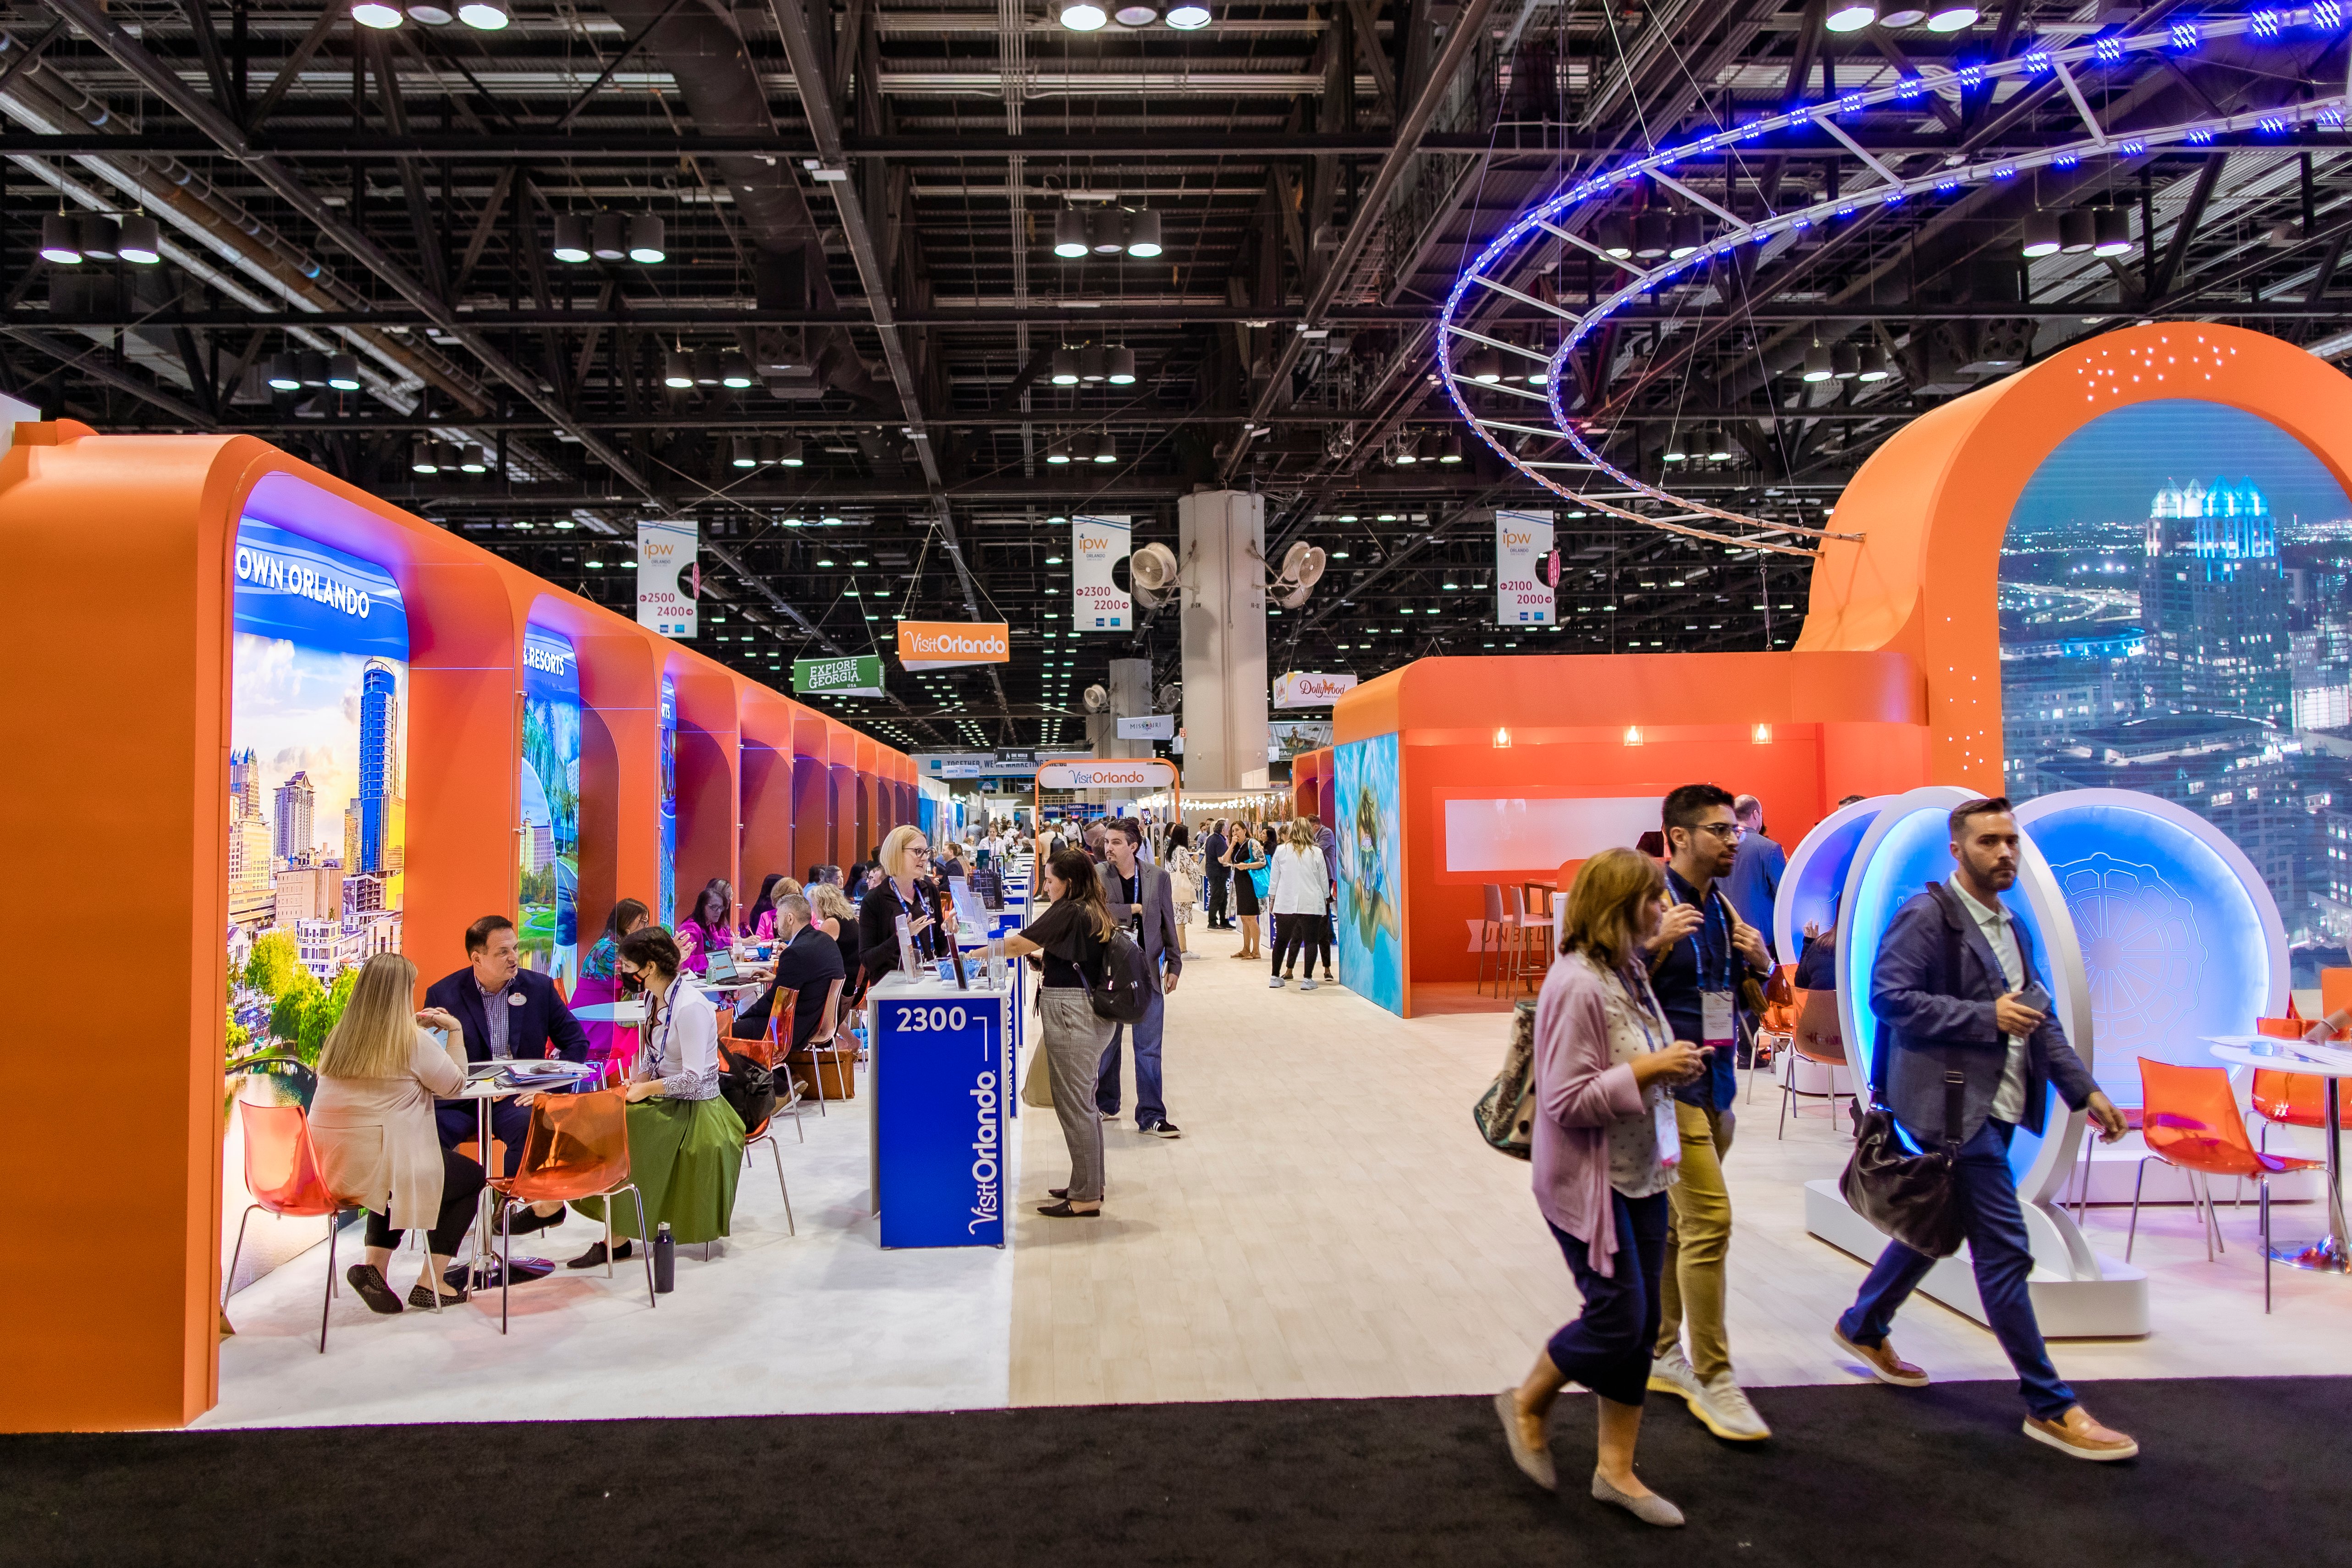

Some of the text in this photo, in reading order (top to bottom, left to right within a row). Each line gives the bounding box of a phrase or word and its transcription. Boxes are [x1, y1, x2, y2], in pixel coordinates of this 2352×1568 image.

[1080, 535, 1108, 553] ipw
[1503, 530, 1531, 548] ipw
[644, 540, 674, 559] ipw
[288, 564, 370, 619] ORLANDO
[1084, 586, 1111, 596] 2300
[1508, 581, 1532, 591] 2100
[648, 593, 675, 603] 2500
[1094, 600, 1120, 610] 2200
[1517, 594, 1543, 604] 2000
[657, 606, 684, 616] 2400
[529, 646, 565, 677] RESORTS
[810, 659, 857, 677] EXPLORE
[809, 670, 859, 689] GEORGIA
[896, 1006, 967, 1033] 2300
